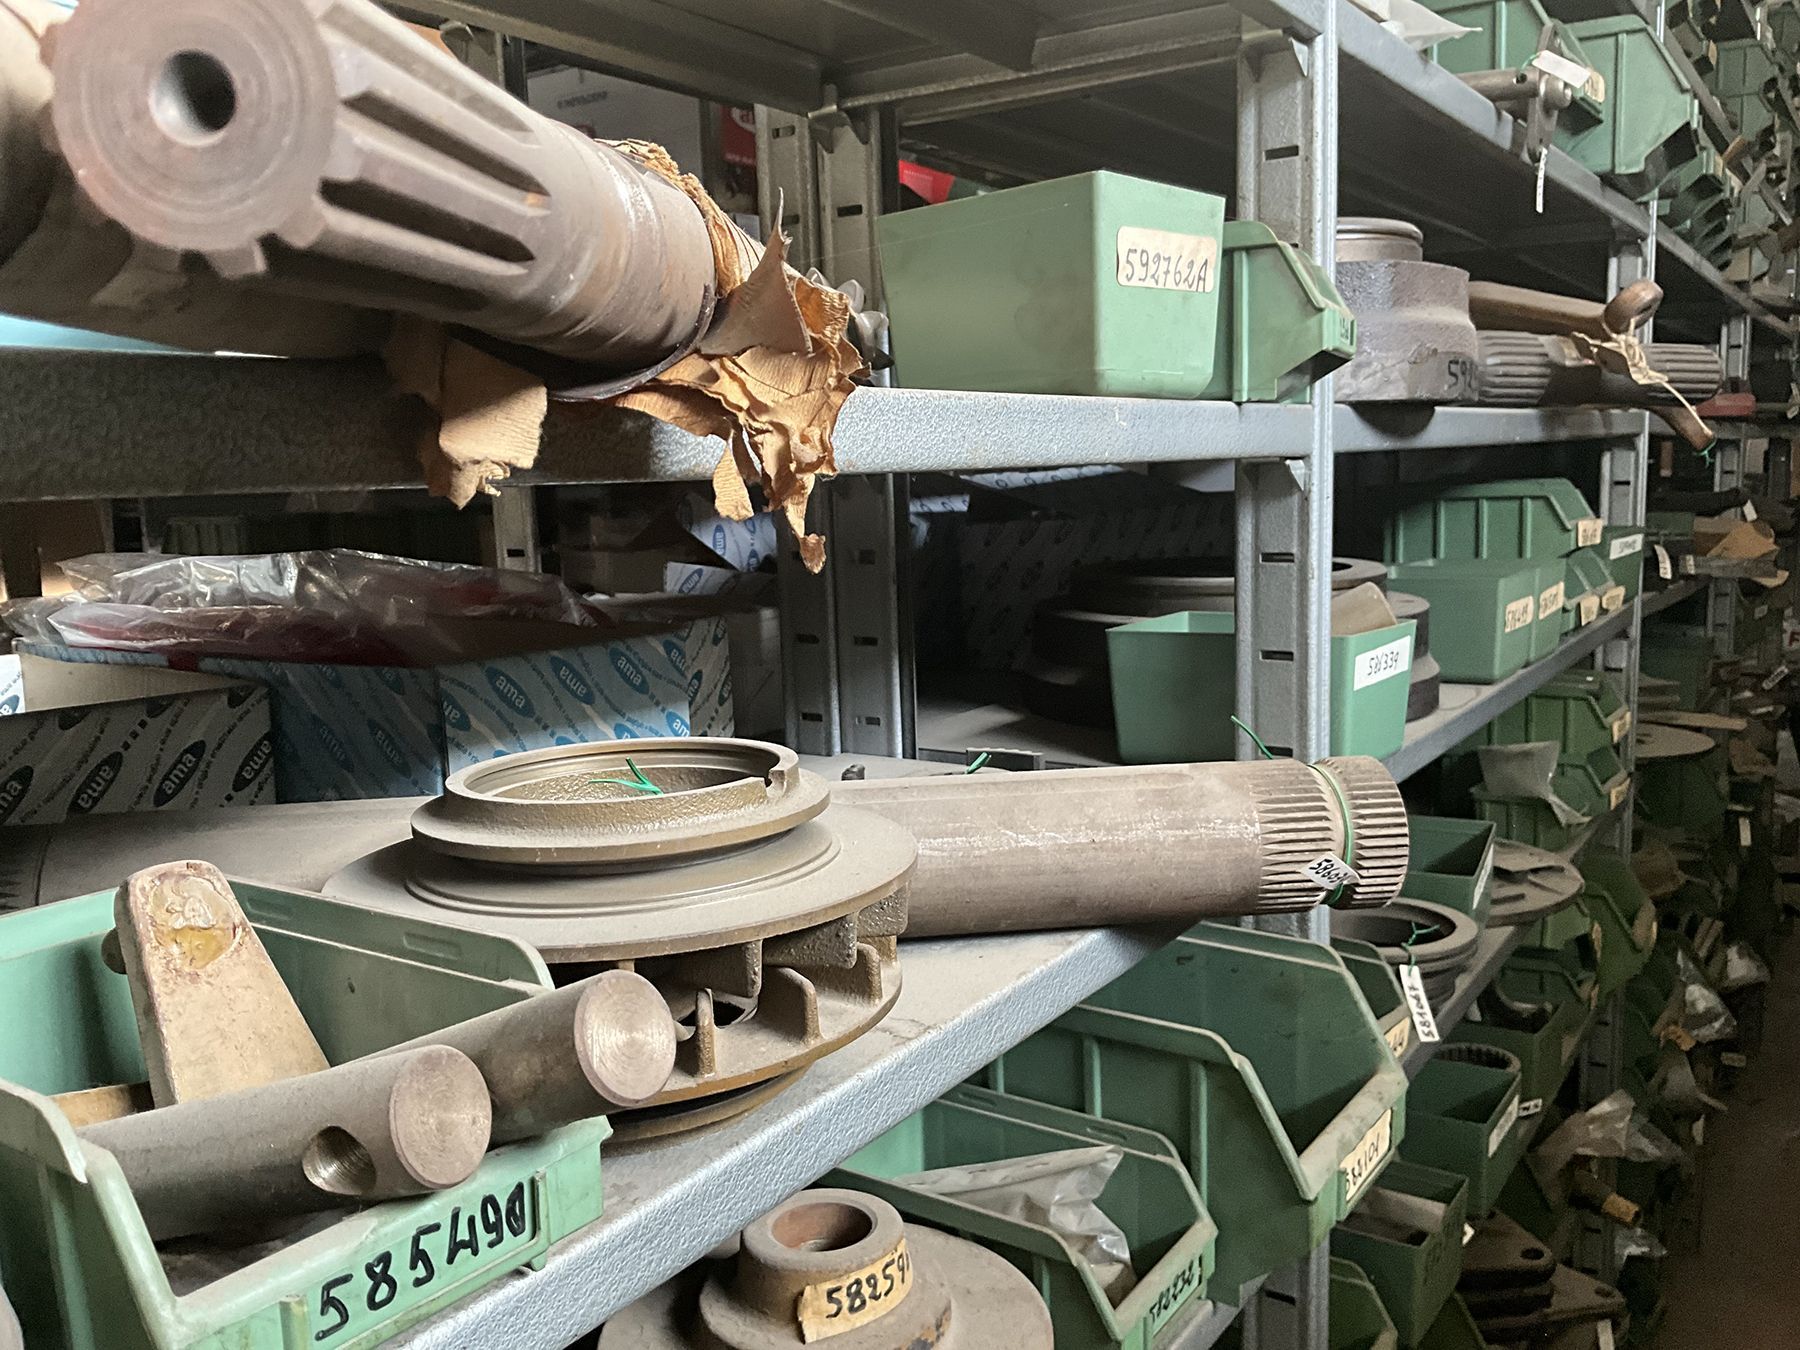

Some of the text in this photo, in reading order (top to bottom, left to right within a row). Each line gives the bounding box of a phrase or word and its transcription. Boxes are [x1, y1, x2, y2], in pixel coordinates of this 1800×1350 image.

[1125, 248, 1209, 293] 592762A
[560, 666, 587, 697] ama
[617, 656, 642, 685] ama
[495, 676, 525, 708] ama
[672, 719, 689, 738] am
[162, 753, 196, 794] ama
[241, 740, 272, 780] ama
[77, 765, 114, 808] ama
[314, 1181, 526, 1341] 585490
